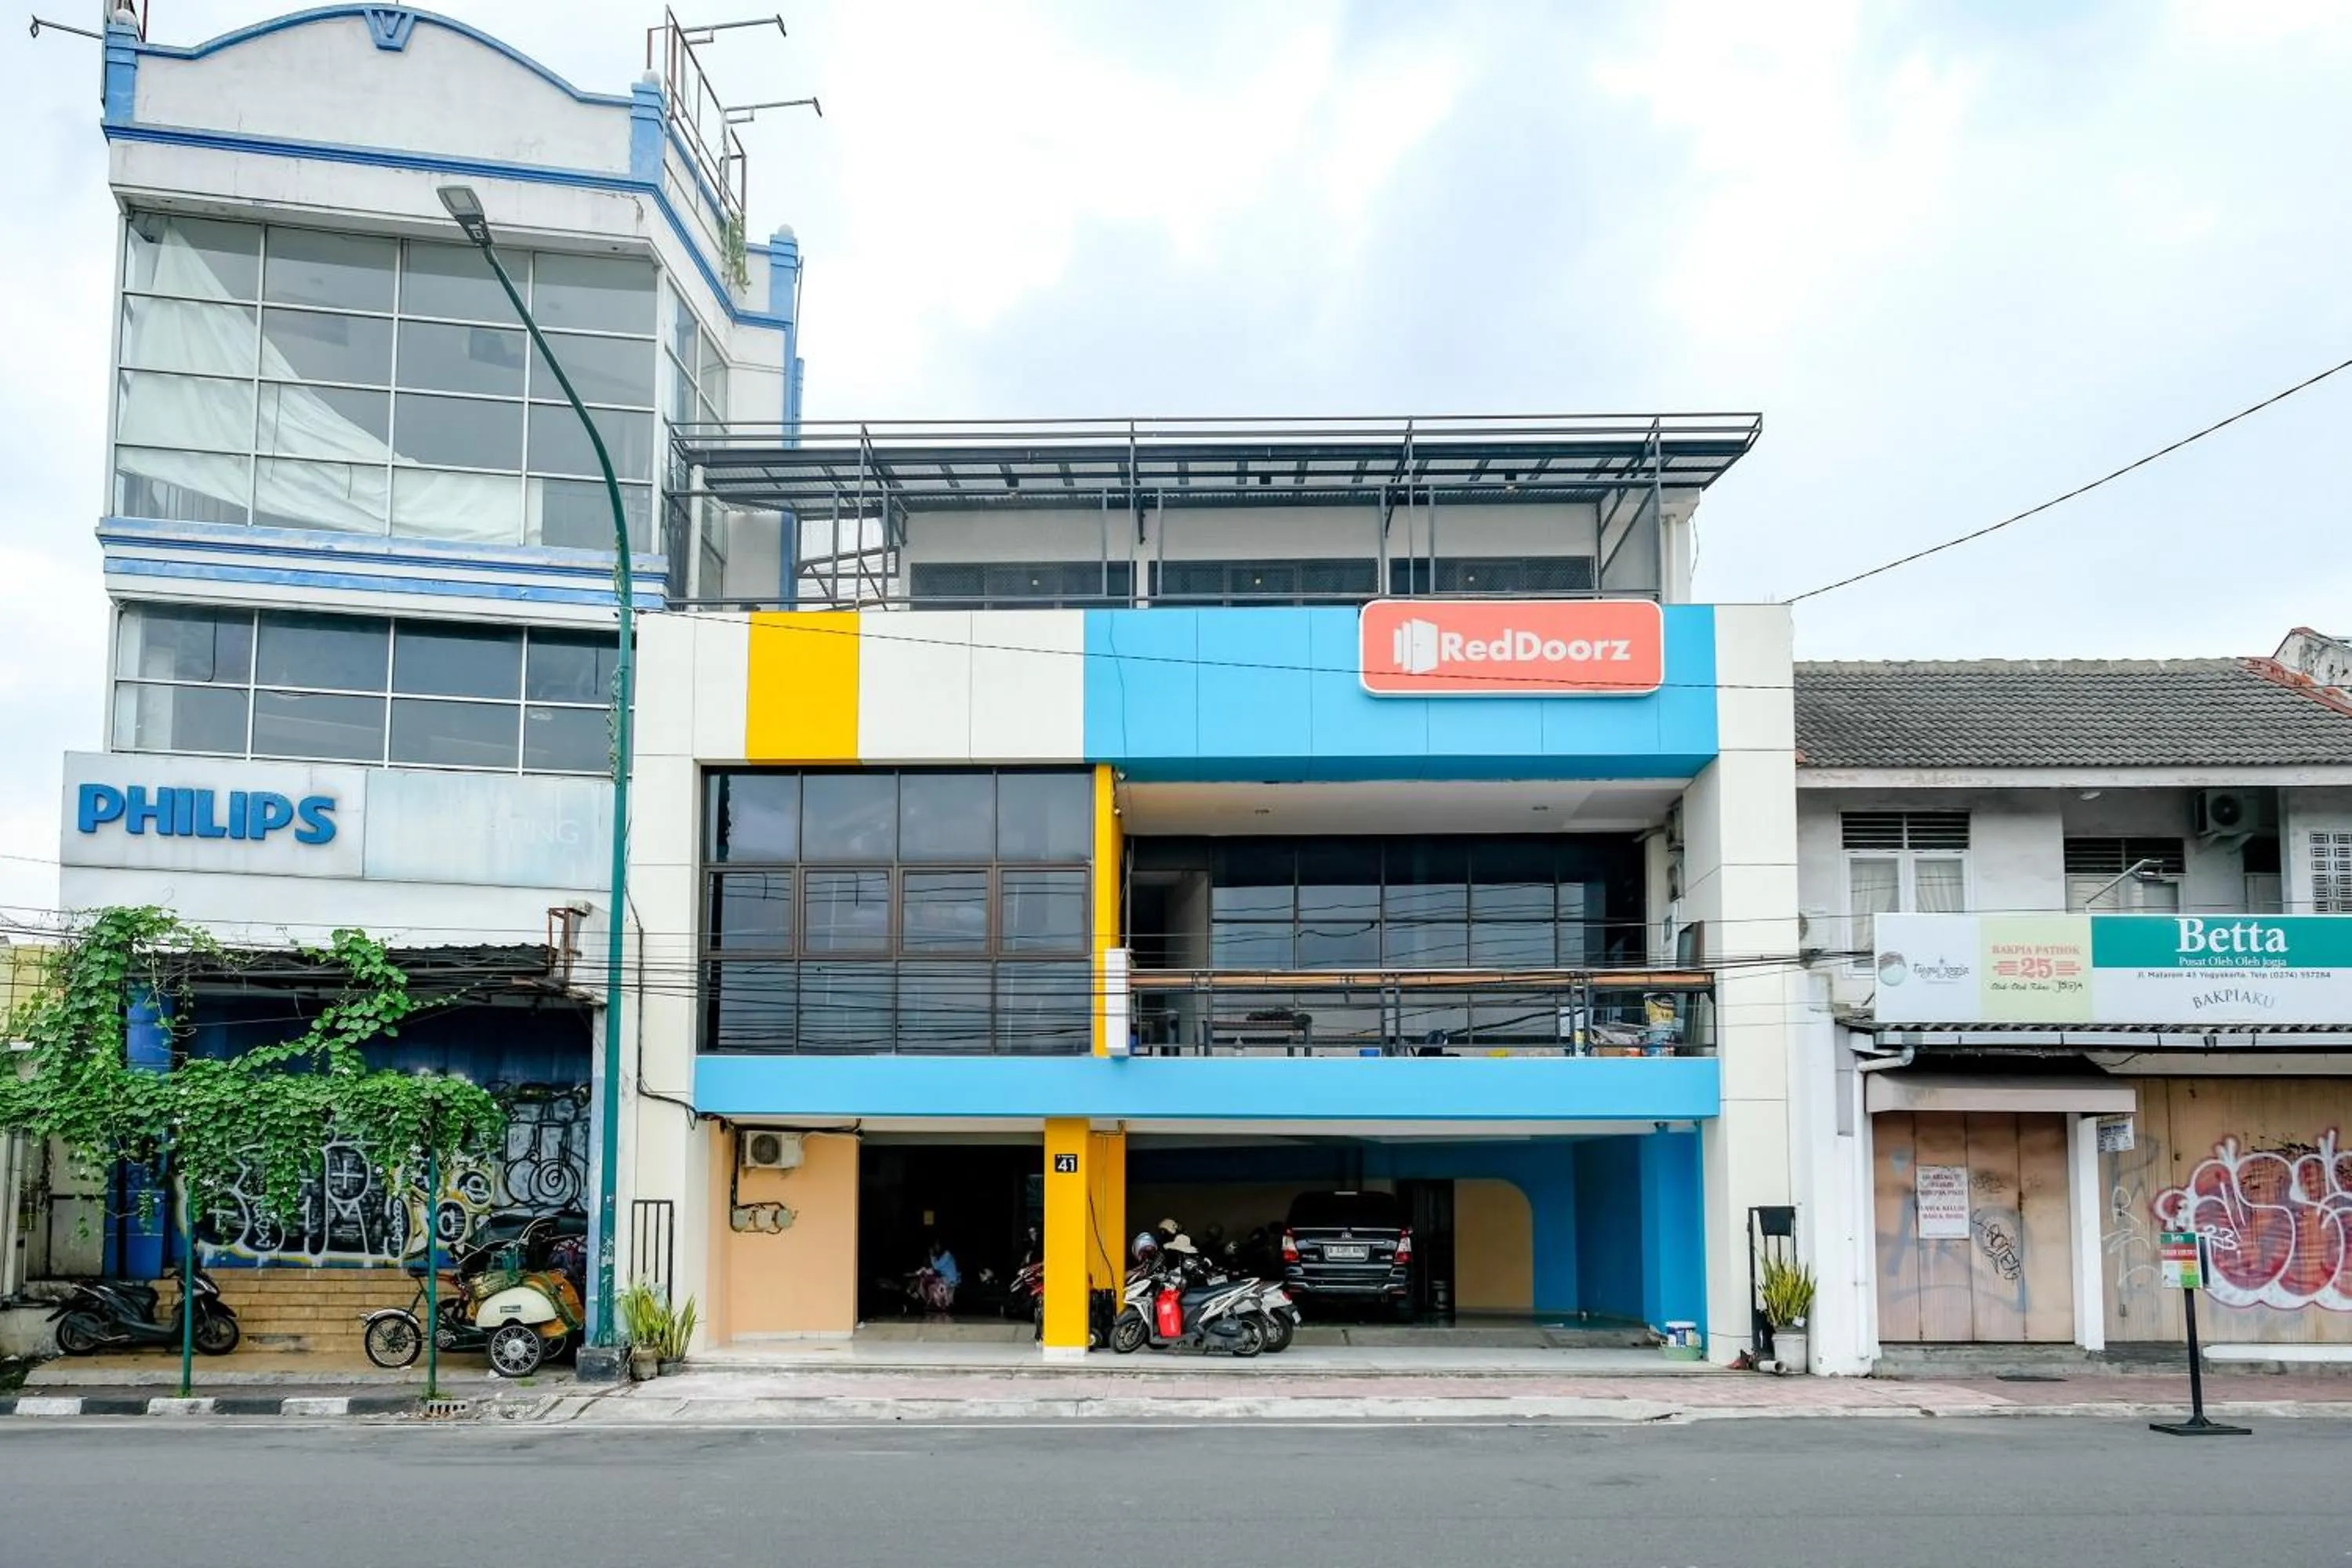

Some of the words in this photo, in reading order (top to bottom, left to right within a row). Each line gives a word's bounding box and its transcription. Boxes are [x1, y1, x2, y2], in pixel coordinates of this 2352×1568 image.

[1441, 628, 1631, 662] RedDoorz
[78, 782, 337, 846] PHILIPS
[2176, 917, 2288, 953] Betta
[1991, 945, 2033, 955] BAKPIA
[2035, 945, 2080, 955] PATHOK
[2020, 956, 2053, 979] 25
[2178, 956, 2206, 967] Pusat
[2209, 956, 2233, 967] Oleh
[2235, 956, 2260, 967] Oleh
[2261, 956, 2288, 969] Jogja
[2192, 988, 2276, 1010] BAKPIAKU
[1057, 1158, 1075, 1172] 41
